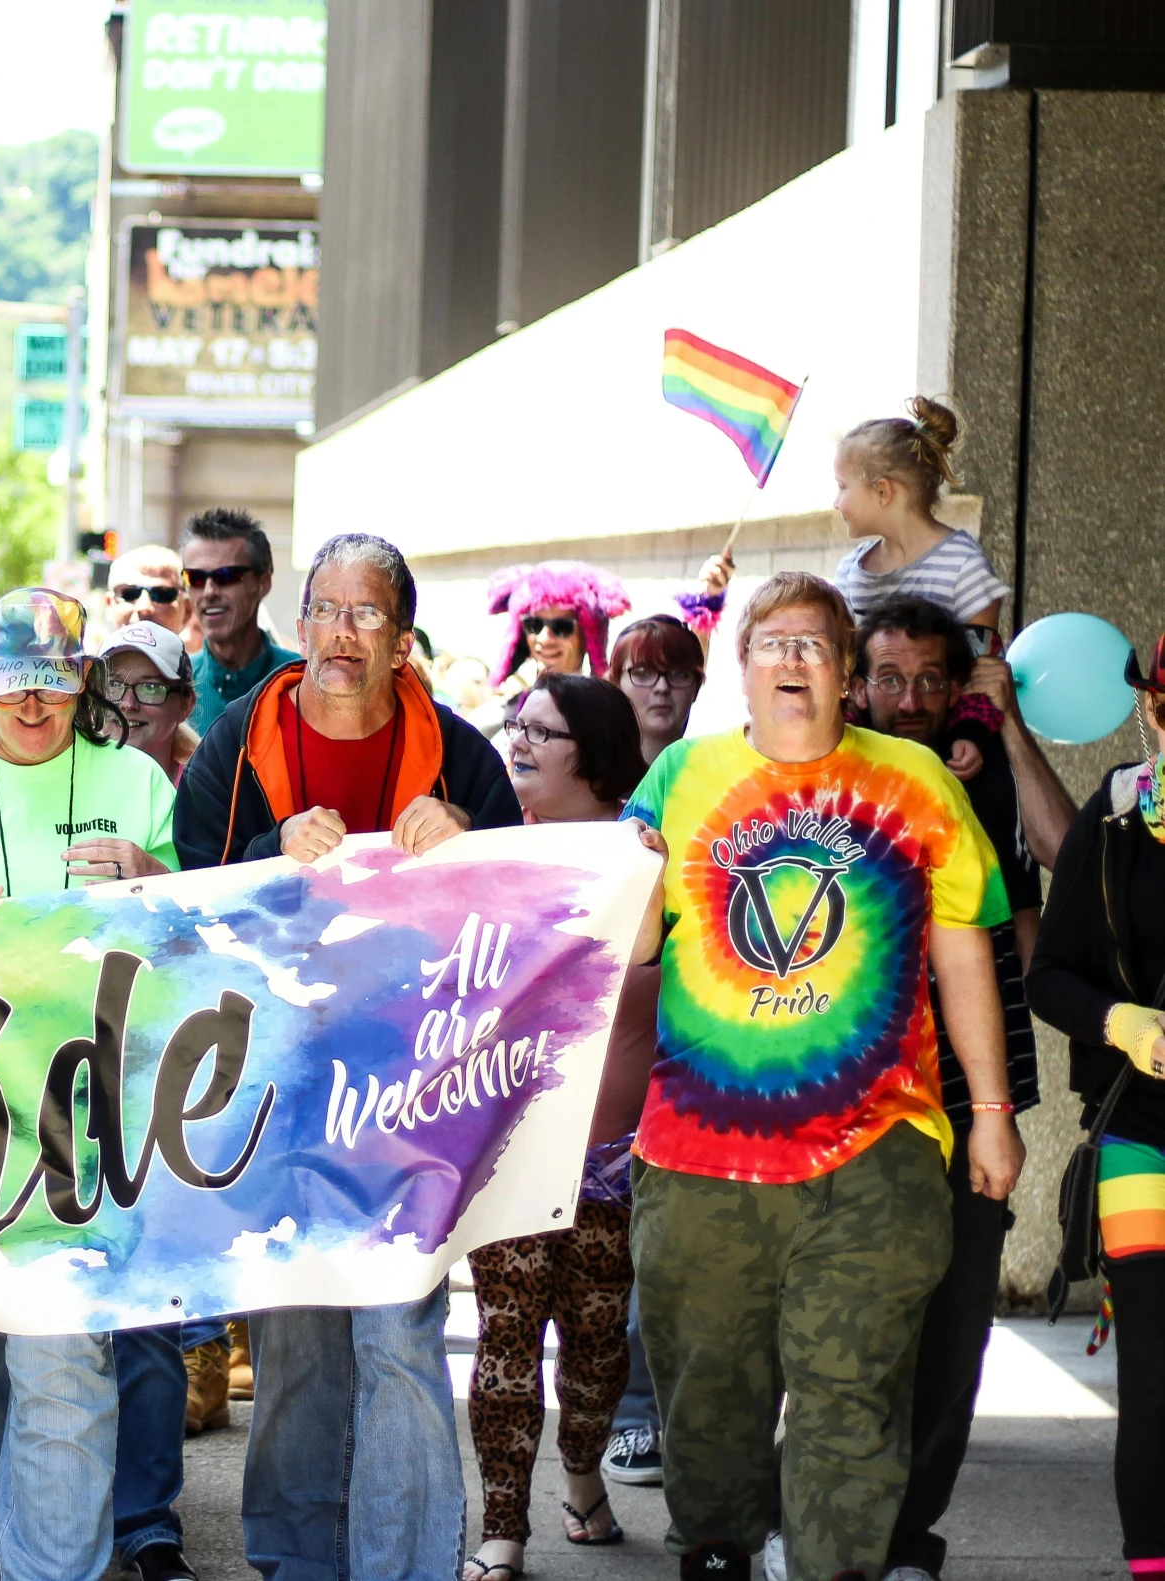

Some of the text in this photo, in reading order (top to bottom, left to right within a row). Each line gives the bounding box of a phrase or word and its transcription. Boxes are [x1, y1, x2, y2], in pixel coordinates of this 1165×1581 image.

[144, 13, 327, 57] RETHINK
[142, 57, 249, 91] DON'T
[156, 229, 321, 269] Fundrai
[127, 336, 202, 367] MAY
[209, 337, 250, 369] 17
[6, 673, 67, 689] PRIDE
[55, 818, 118, 835] VOLUNTEER
[711, 808, 867, 870] Ohio Valley
[419, 911, 513, 1000] All
[749, 981, 831, 1019] Pride
[414, 998, 503, 1061] are
[324, 1030, 550, 1150] Welcome!
